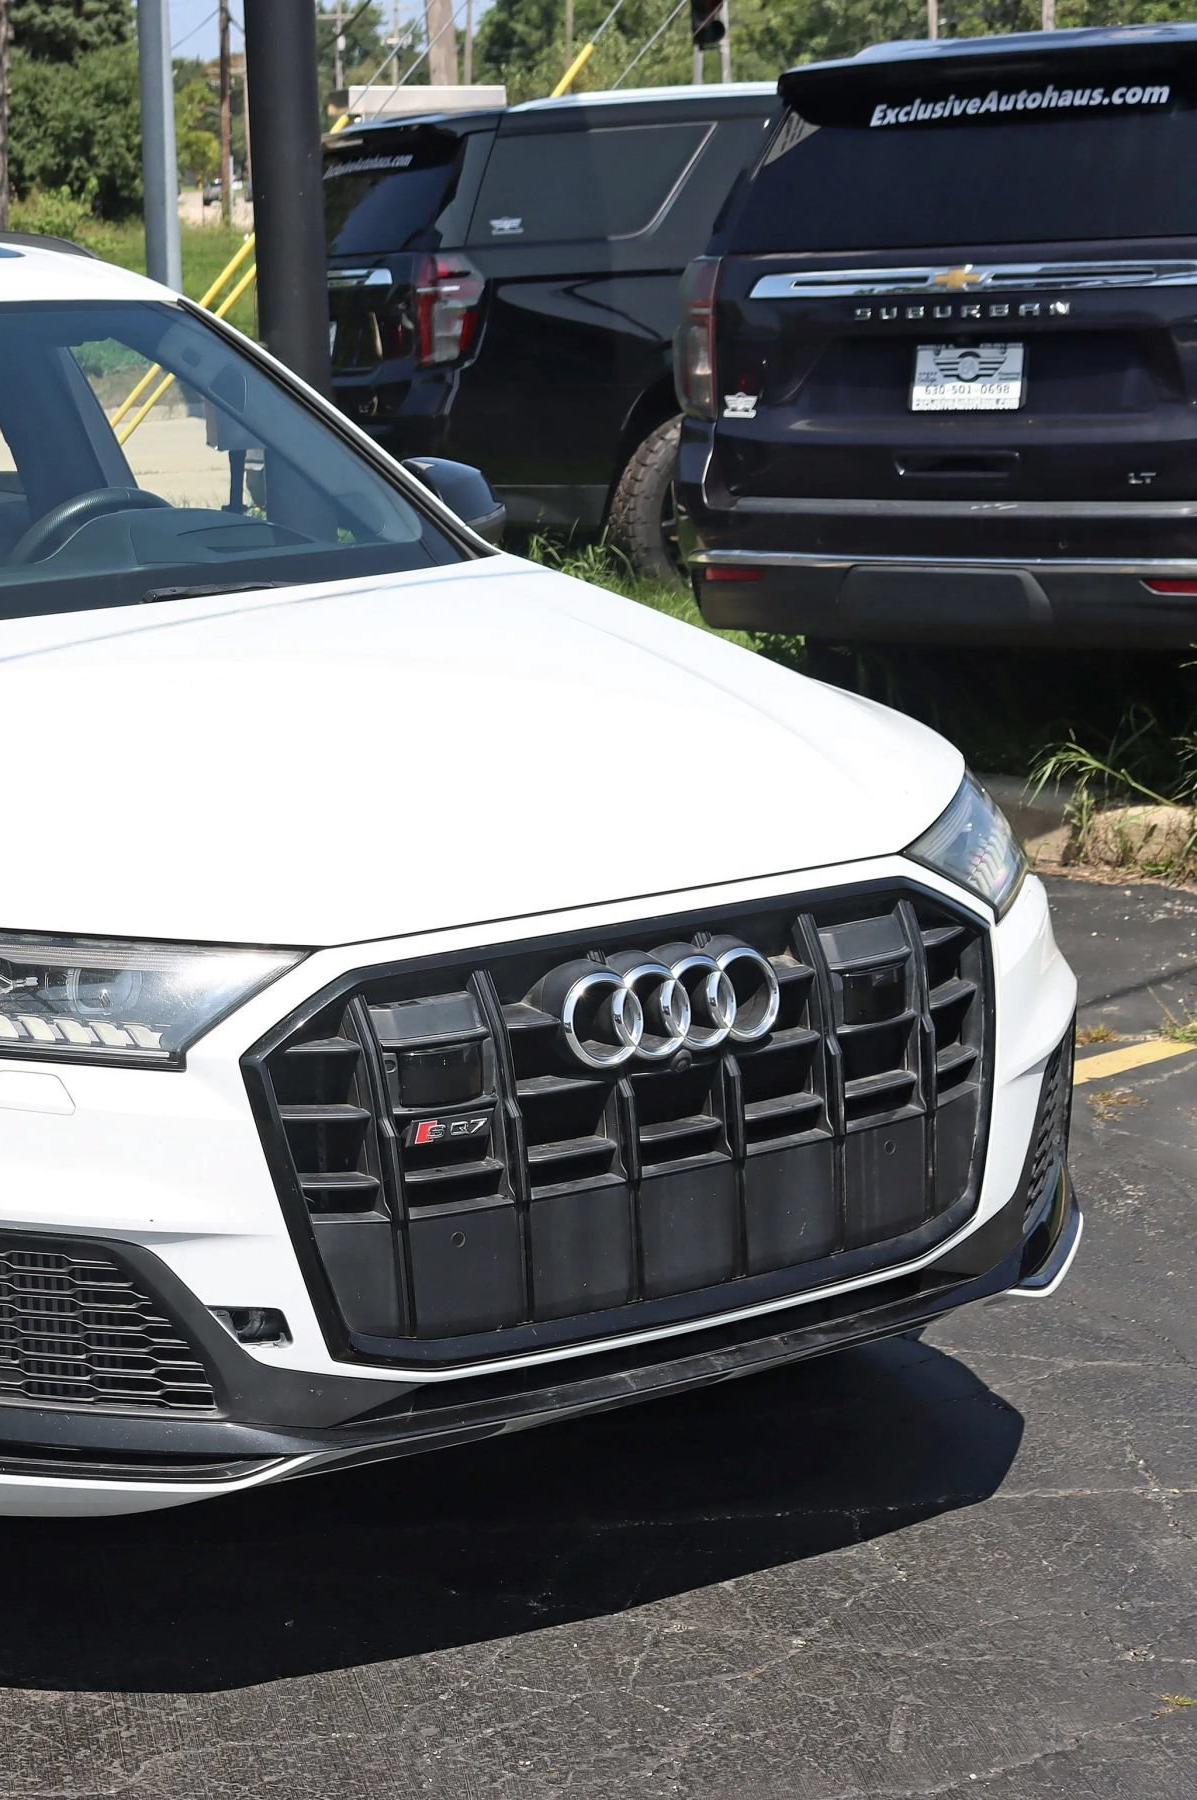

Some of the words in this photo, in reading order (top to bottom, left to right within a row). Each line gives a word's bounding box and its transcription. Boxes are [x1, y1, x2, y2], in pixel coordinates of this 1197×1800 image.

[869, 84, 1171, 127] ExclusiveAutohaus.com
[854, 301, 1071, 321] SUBURBAN
[1127, 471, 1158, 485] LT
[414, 1117, 489, 1145] SQ7
